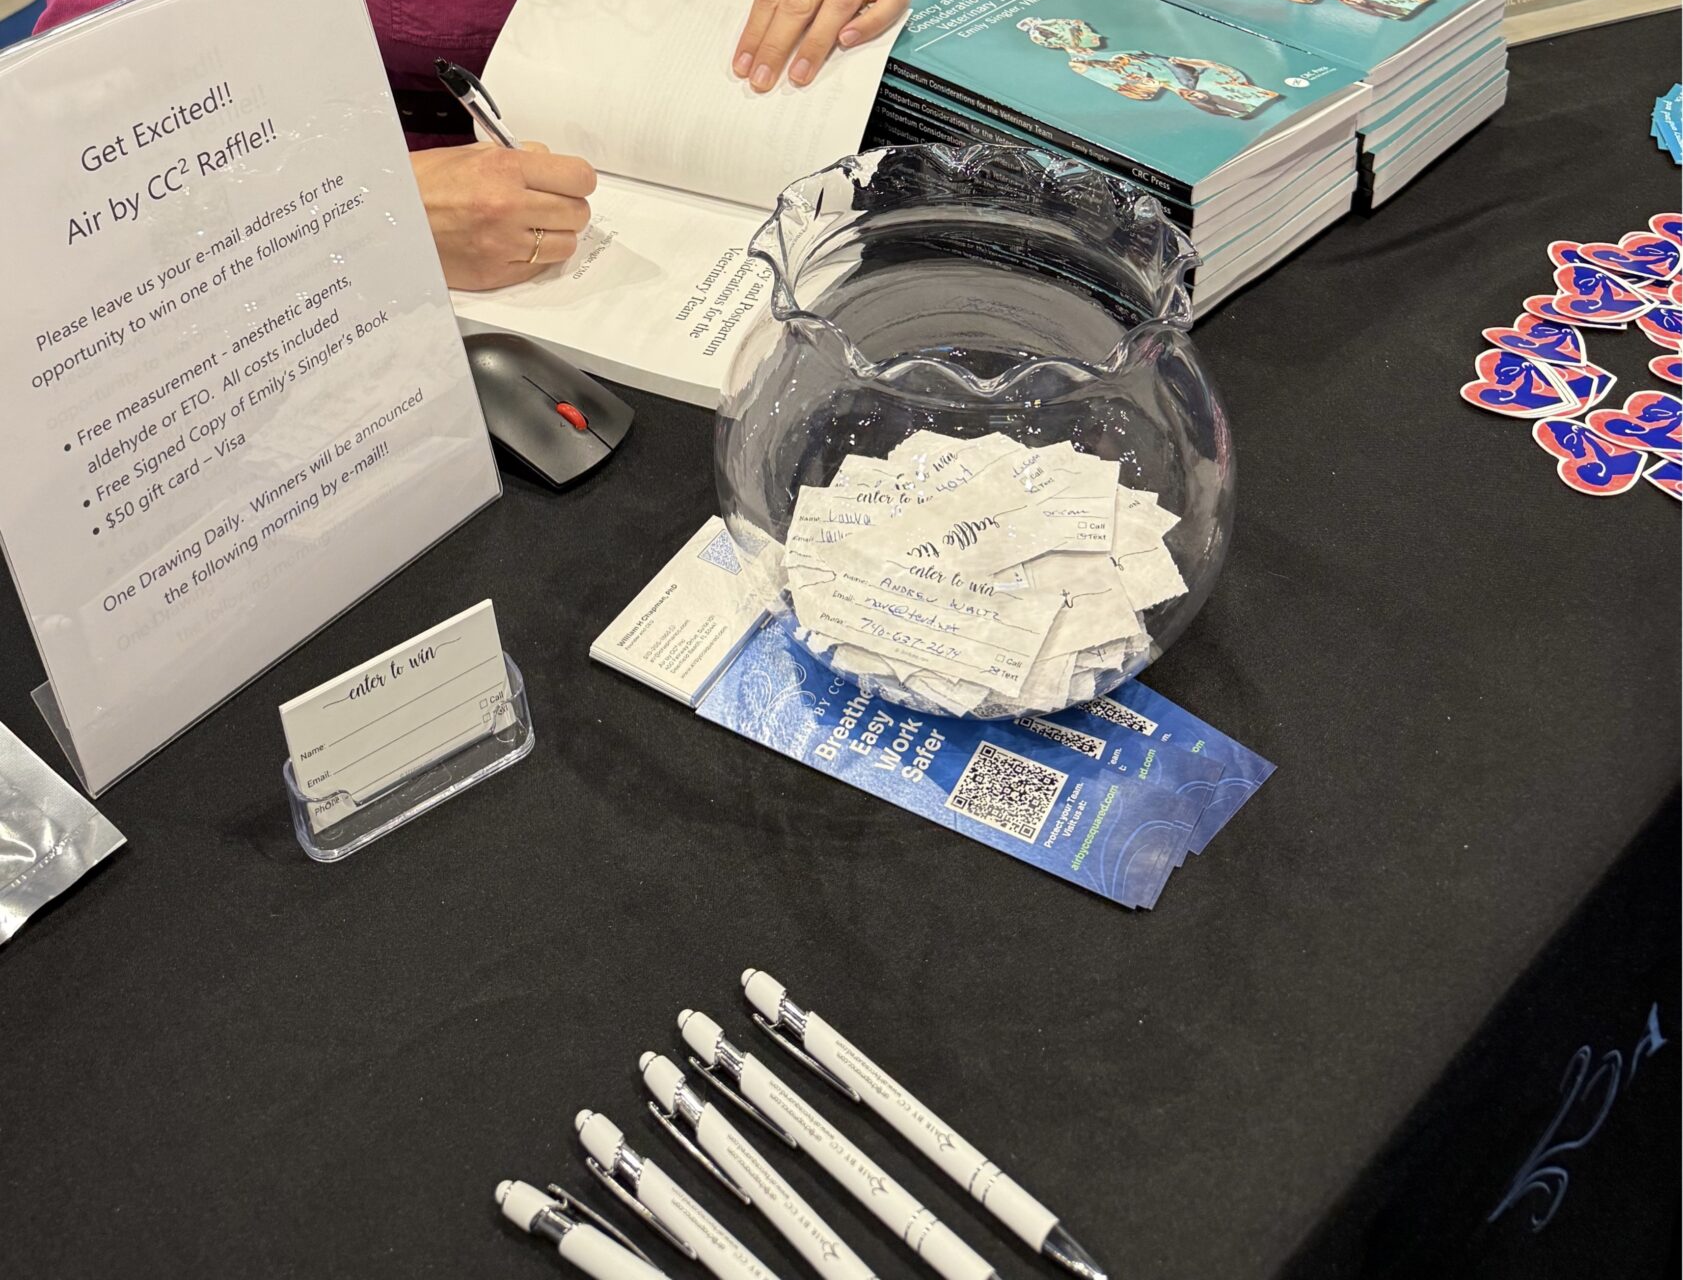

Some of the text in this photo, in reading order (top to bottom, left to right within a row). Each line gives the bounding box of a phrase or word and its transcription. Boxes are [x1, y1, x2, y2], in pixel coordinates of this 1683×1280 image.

[936, 1, 997, 30] Veterinary
[958, 21, 988, 38] Emily
[81, 82, 233, 171] Get Excited!!
[893, 65, 928, 86] Postpartum
[929, 80, 975, 106] Considerations
[976, 100, 990, 110] for
[987, 105, 998, 115] the
[999, 106, 1033, 132] Veterinary
[1035, 125, 1052, 139] Team
[1072, 142, 1087, 154] Emily
[1132, 168, 1149, 181] CRC
[1151, 175, 1171, 190] Press
[69, 118, 277, 245] Air by CC² Raffle!!
[32, 194, 363, 388] opportunity to win one of the following prizes:
[36, 176, 344, 351] Please leave us your e-mail address for the
[77, 276, 352, 445] Free measurement anesthetic agents,
[88, 309, 339, 473] aldehyde or ETO. All costs included
[96, 310, 389, 501] Free Signed Copy of Emily's Singler's Book
[103, 388, 423, 611] One Drawing Daily. Winners will be announced
[106, 433, 245, 528] $50 gift card Visa
[164, 441, 389, 604] the following morning by e-mail!!
[617, 624, 638, 647] William
[666, 584, 678, 596] PhD
[349, 646, 437, 700] enter to win
[489, 691, 503, 704] Call
[300, 744, 326, 761] Name:
[813, 689, 874, 761] Breathe
[849, 710, 894, 756] Easy
[874, 718, 923, 771] Work
[901, 729, 945, 783] Safer
[1044, 782, 1084, 848] Protect your Team.
[1071, 784, 1118, 871] airbyccsquared.com
